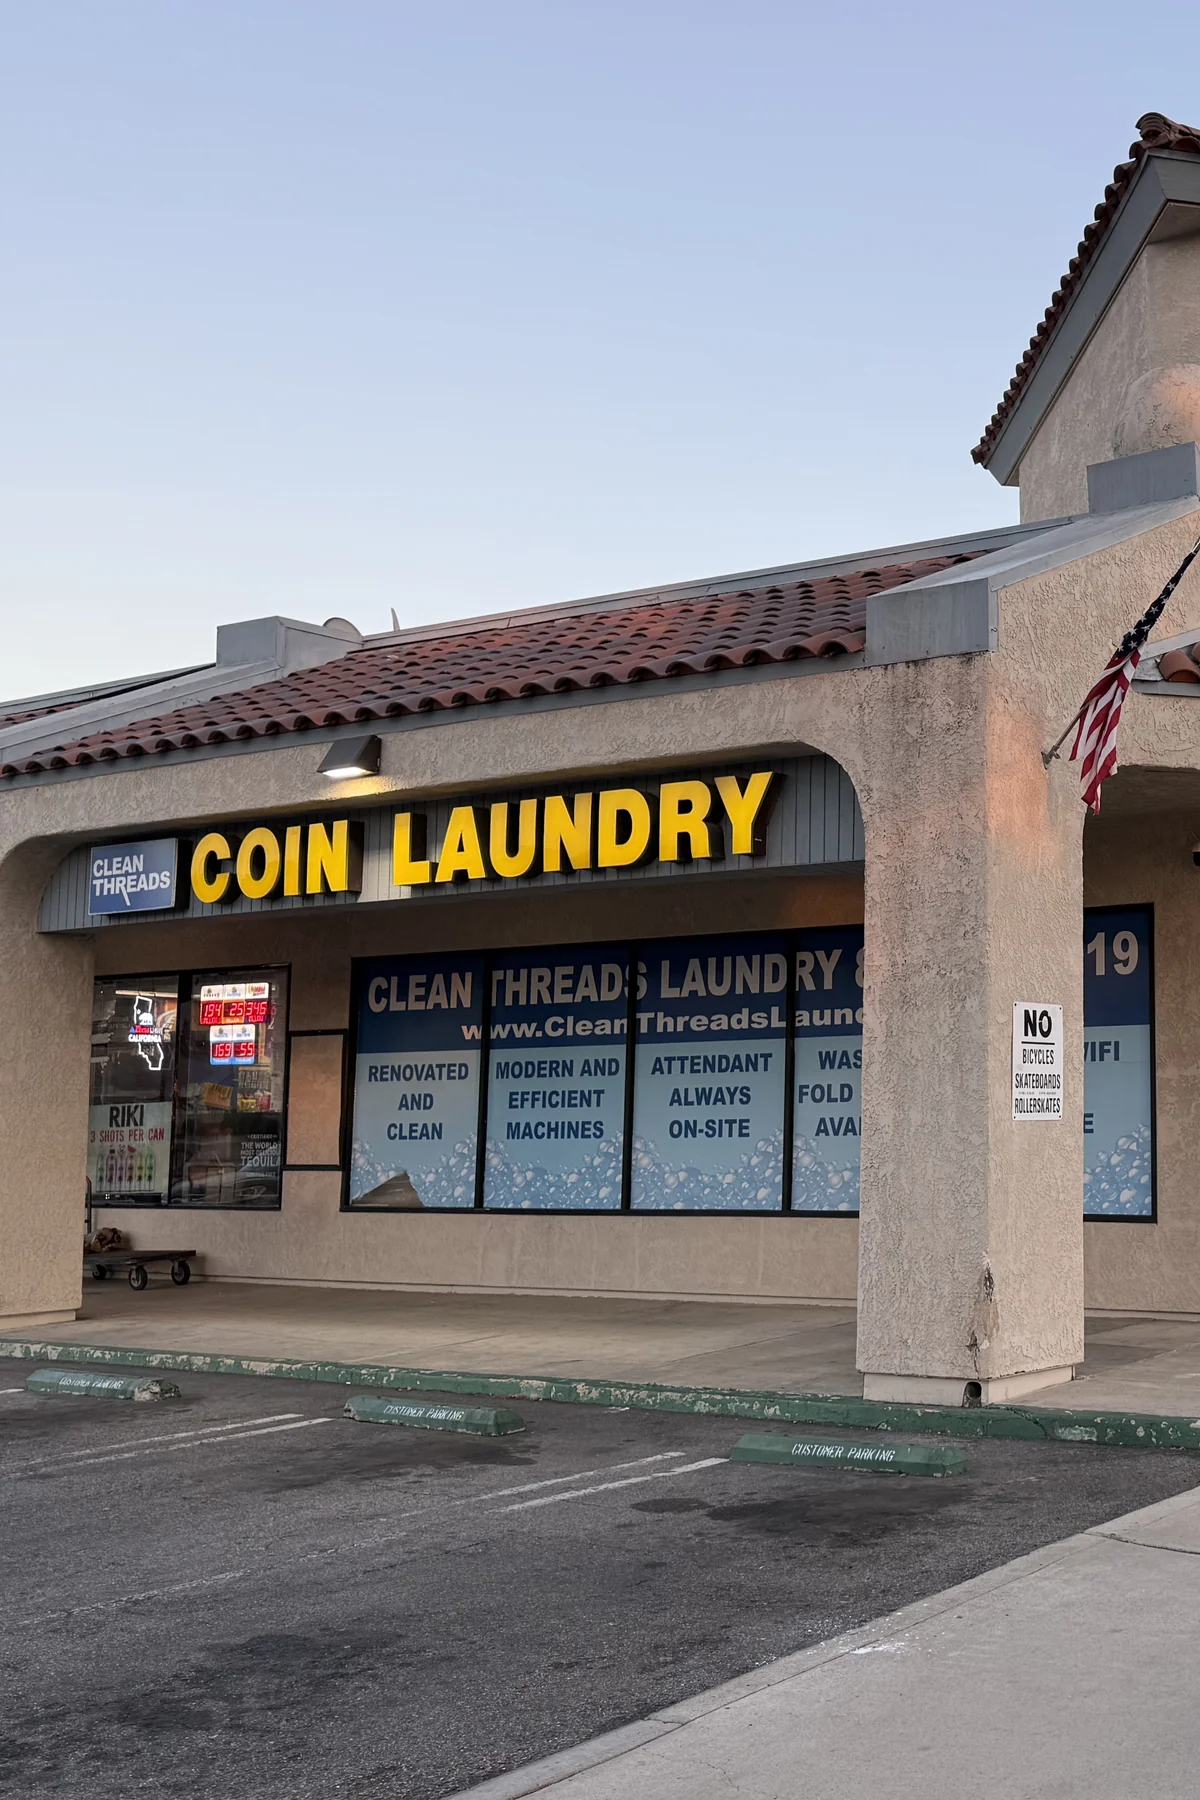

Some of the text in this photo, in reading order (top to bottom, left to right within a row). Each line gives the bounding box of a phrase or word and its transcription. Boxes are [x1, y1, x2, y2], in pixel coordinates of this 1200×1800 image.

[190, 770, 773, 904] COIN LAUNDRY
[93, 853, 144, 879] CLEAN
[92, 868, 171, 907] THREADS
[1086, 930, 1139, 976] 19
[368, 971, 473, 1013] CLEAN
[491, 961, 648, 1008] THREADS
[660, 948, 843, 999] LAUNDRY
[229, 1003, 244, 1016] 25
[1023, 1009, 1053, 1039] NO
[128, 1033, 162, 1043] CALIFORNIA
[239, 1042, 254, 1057] 55
[1022, 1048, 1055, 1065] BICYCLES
[368, 1062, 470, 1083] RENOVATED
[495, 1057, 620, 1080] MODERN AND
[651, 1052, 773, 1075] ATTENDANT
[1015, 1072, 1061, 1090] SKATEBOARDS
[398, 1092, 434, 1111] AND
[508, 1089, 605, 1110] EFFICIENT
[669, 1086, 752, 1107] ALWAYS
[798, 1083, 853, 1104] FOLD
[109, 1104, 145, 1128] RIKI
[1014, 1097, 1061, 1114] ROLLERSKATES
[90, 1127, 165, 1143] 3 SHOTS PER CAN
[387, 1122, 443, 1141] CLEAN
[506, 1120, 605, 1140] MACHINES
[668, 1118, 750, 1139] ON-SITE
[240, 1141, 254, 1150] THE
[383, 1404, 465, 1420] CUSTOMER PARKING
[791, 1443, 896, 1463] CUSTOMER PARKING
